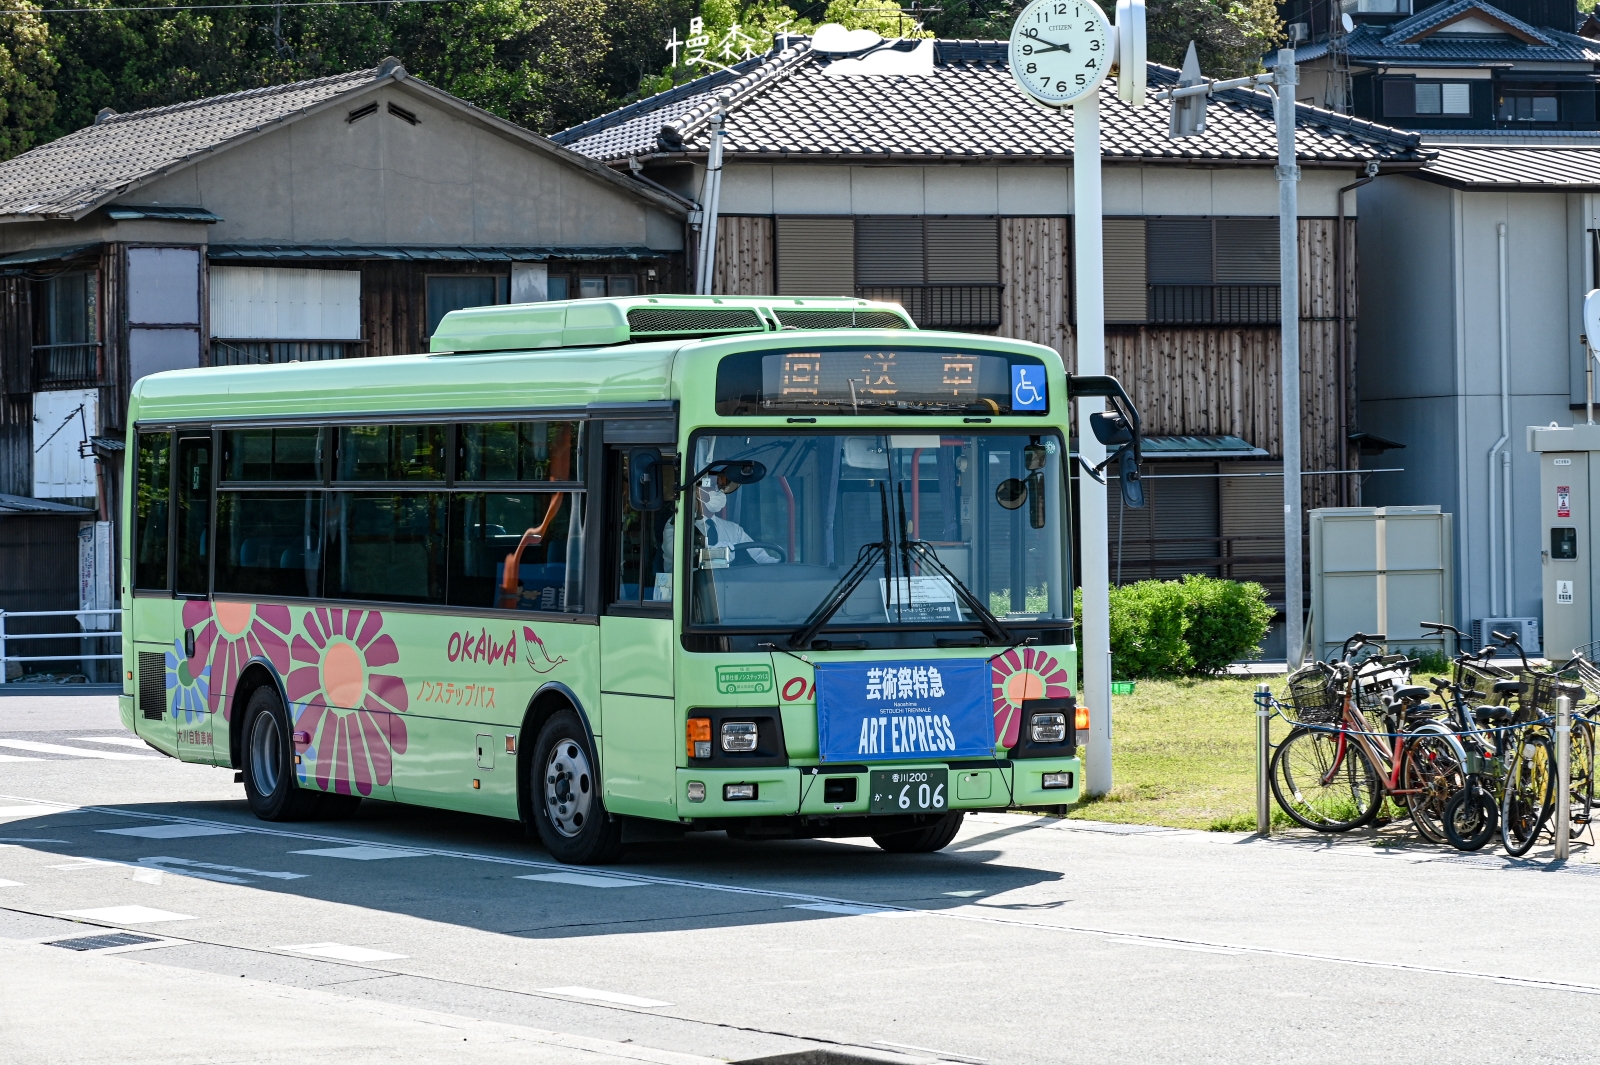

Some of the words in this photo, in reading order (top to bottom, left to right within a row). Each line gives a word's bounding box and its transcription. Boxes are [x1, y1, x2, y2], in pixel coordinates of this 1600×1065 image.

[1053, 3, 1067, 15] 12
[1075, 6, 1079, 18] 1
[1036, 12, 1049, 23] 11
[1048, 24, 1073, 32] CITIZEN
[1084, 20, 1095, 32] 2
[1022, 44, 1033, 56] 9
[1089, 39, 1100, 51] 3
[1026, 62, 1037, 74] 8
[1084, 58, 1097, 69] 4
[1040, 76, 1051, 88] 7
[1075, 73, 1086, 85] 5
[1056, 81, 1067, 93] 6
[447, 627, 517, 666] OKAWA
[866, 666, 945, 701] 芸術祭特急
[416, 680, 496, 709] ノンステップバス
[858, 716, 888, 755] ART
[891, 714, 956, 753] EXPRESS
